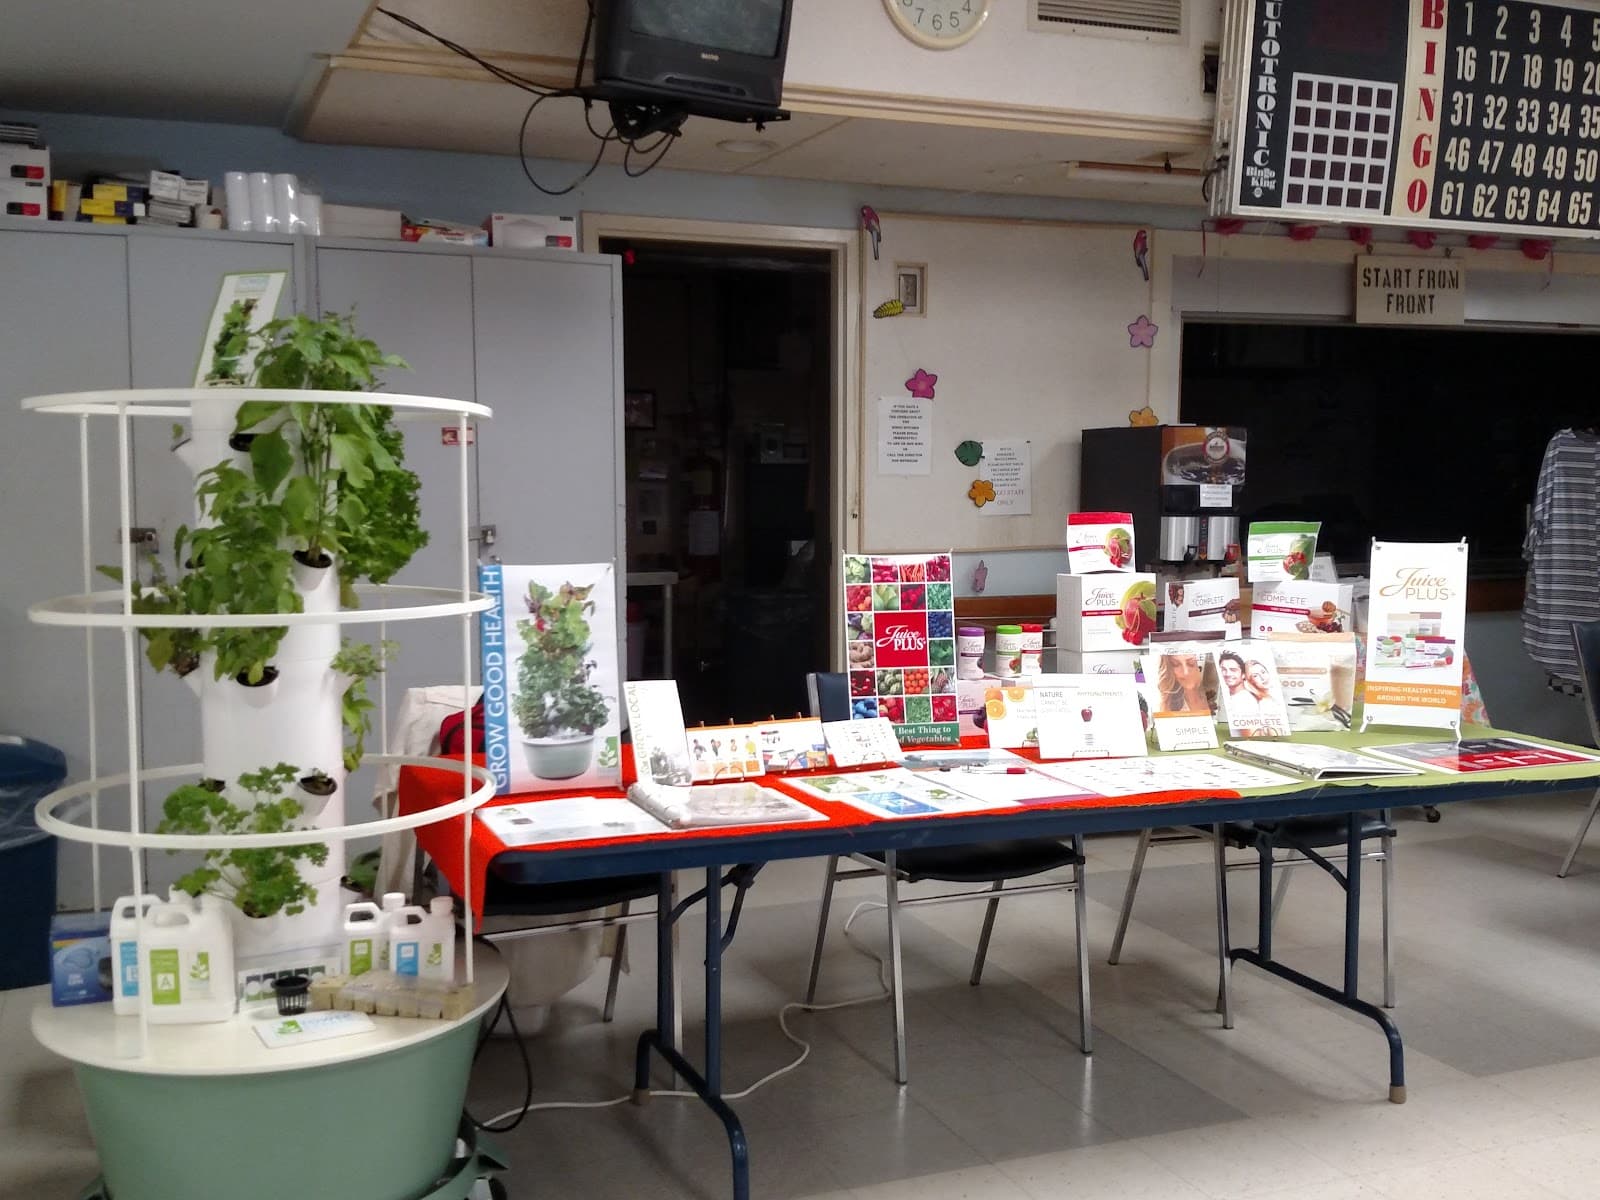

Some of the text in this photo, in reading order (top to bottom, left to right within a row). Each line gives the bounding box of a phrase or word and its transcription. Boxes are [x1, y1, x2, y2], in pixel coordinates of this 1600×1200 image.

[915, 8, 925, 24] 7
[932, 14, 942, 31] 6
[949, 12, 960, 28] 5
[1465, 2, 1473, 36] 1
[1495, 6, 1508, 40] 2
[1528, 9, 1541, 44] 3
[1560, 14, 1572, 48] 4
[1456, 46, 1477, 82] 16
[1489, 50, 1511, 85] 17
[1522, 54, 1543, 89] 18
[1554, 58, 1574, 93] 19
[1253, 0, 1282, 166] UTOTRONIC
[1407, 0, 1445, 213] BINGO
[1450, 91, 1600, 140] 31 32 33 34 35
[1444, 136, 1599, 183] 46 47 48 49 50
[1246, 166, 1276, 179] Bingo
[1251, 176, 1277, 190] King
[1440, 181, 1593, 225] 61 62 63 64 65
[1362, 267, 1460, 290] START FROM
[1386, 294, 1436, 315] FRONT
[1379, 565, 1447, 597] Juice
[1085, 587, 1115, 606] Juice
[1260, 592, 1307, 606] COMPLETE
[876, 624, 921, 648] Juice
[485, 651, 505, 718] GOOD
[1367, 685, 1402, 694] INSPIRING
[1402, 687, 1433, 695] HEALTHY
[898, 726, 916, 735] Best
[918, 725, 941, 736] Thing
[942, 725, 951, 733] to
[1175, 726, 1209, 736] SIMPLE
[1233, 718, 1281, 727] COMPLETE
[907, 735, 952, 745] Vegetables
[160, 974, 173, 989] A
